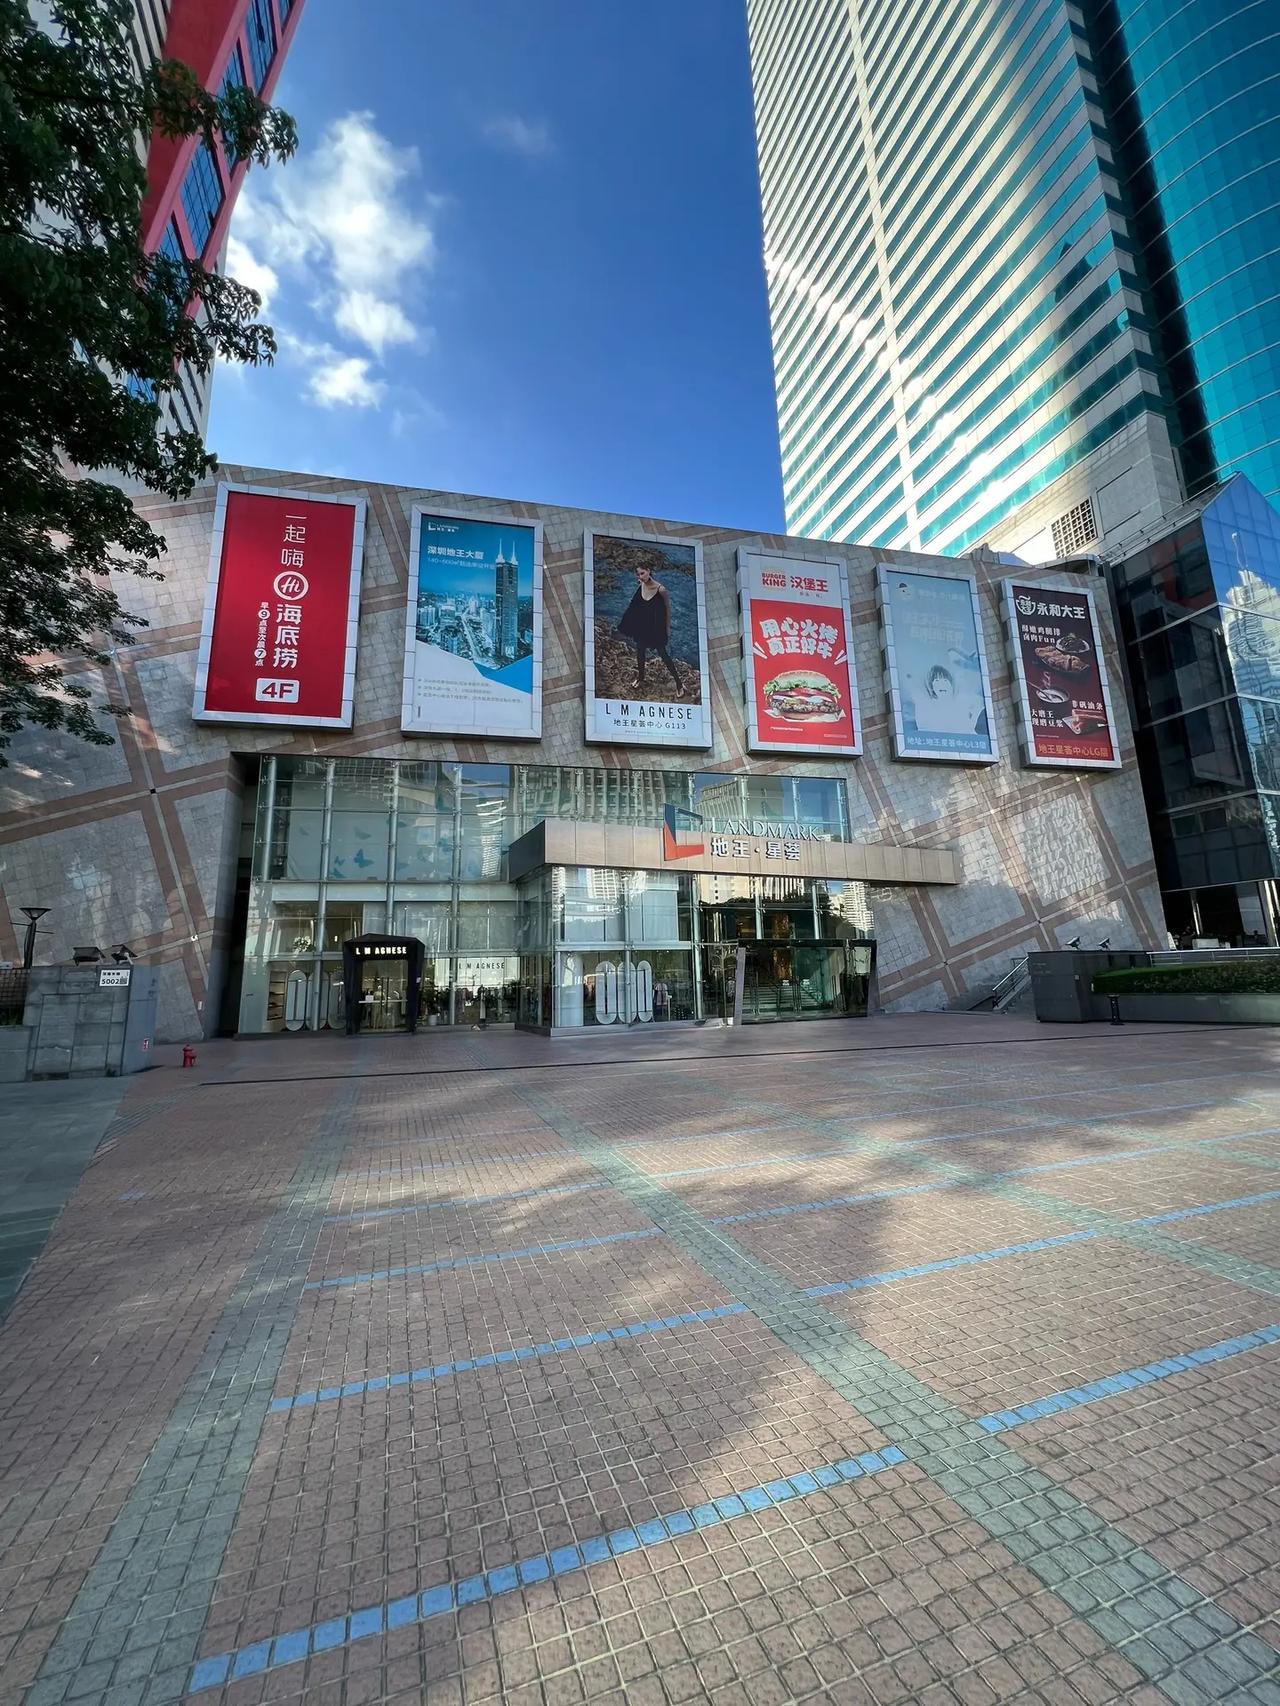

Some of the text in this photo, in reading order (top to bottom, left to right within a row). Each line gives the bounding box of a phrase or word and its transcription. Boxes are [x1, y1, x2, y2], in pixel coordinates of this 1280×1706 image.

[281, 514, 308, 568] 一起嗨
[427, 545, 484, 560] 深圳地王大厦
[761, 572, 786, 580] BURGER
[762, 578, 787, 588] KING
[790, 575, 829, 593] 汉堡王
[1036, 602, 1086, 619] 永和大王
[272, 603, 302, 669] 海底捞
[261, 682, 295, 699] 4F
[605, 703, 693, 720] L M AGNESE
[711, 816, 821, 841] LANDMARK
[375, 946, 407, 955] AGNESE
